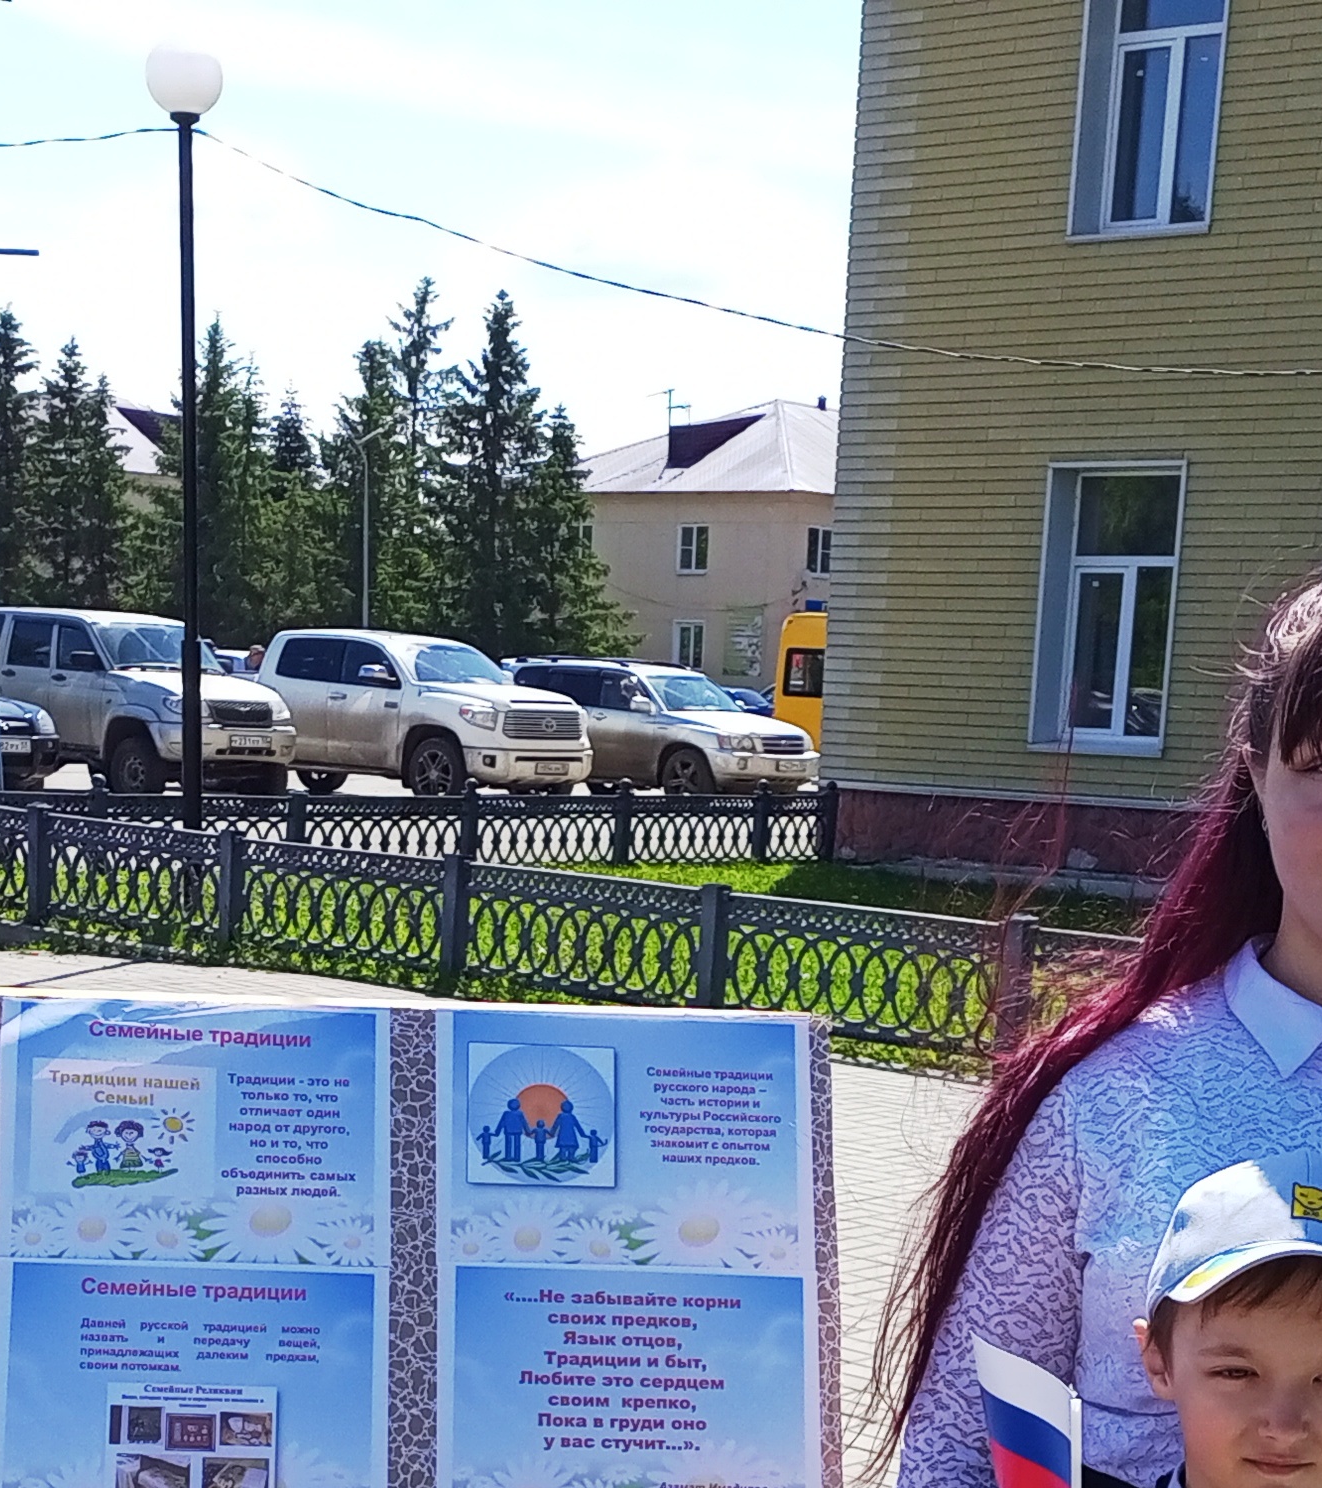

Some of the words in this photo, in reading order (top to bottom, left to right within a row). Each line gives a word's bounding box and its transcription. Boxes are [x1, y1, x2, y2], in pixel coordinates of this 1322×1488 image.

[90, 1020, 203, 1042] Семейные
[210, 1029, 311, 1048] традиции
[50, 1070, 137, 1088] Традиции
[144, 1075, 200, 1090] нашей
[647, 1067, 711, 1079] Семейные
[714, 1070, 773, 1081] традиции
[94, 1091, 154, 1106] Семьи!
[82, 1278, 196, 1298] Семейные
[203, 1284, 306, 1302] традиции
[571, 1292, 677, 1307] забывайте
[683, 1296, 741, 1309] корни
[548, 1312, 605, 1325] своих
[612, 1315, 697, 1329] предков,
[563, 1332, 616, 1345] Язык
[622, 1336, 682, 1349] отцов,
[544, 1351, 640, 1367] Традиции
[648, 1358, 658, 1367] и
[665, 1355, 707, 1371] быт,
[519, 1372, 596, 1386] Любите
[602, 1375, 634, 1387] это
[640, 1377, 724, 1391] сердцем
[548, 1396, 610, 1407] своим
[622, 1398, 696, 1411] крепко,
[538, 1413, 586, 1427] Пока
[594, 1418, 603, 1427] в
[610, 1418, 664, 1431] груди
[671, 1420, 707, 1430] оно
[544, 1438, 554, 1450] у
[561, 1437, 595, 1447] вас
